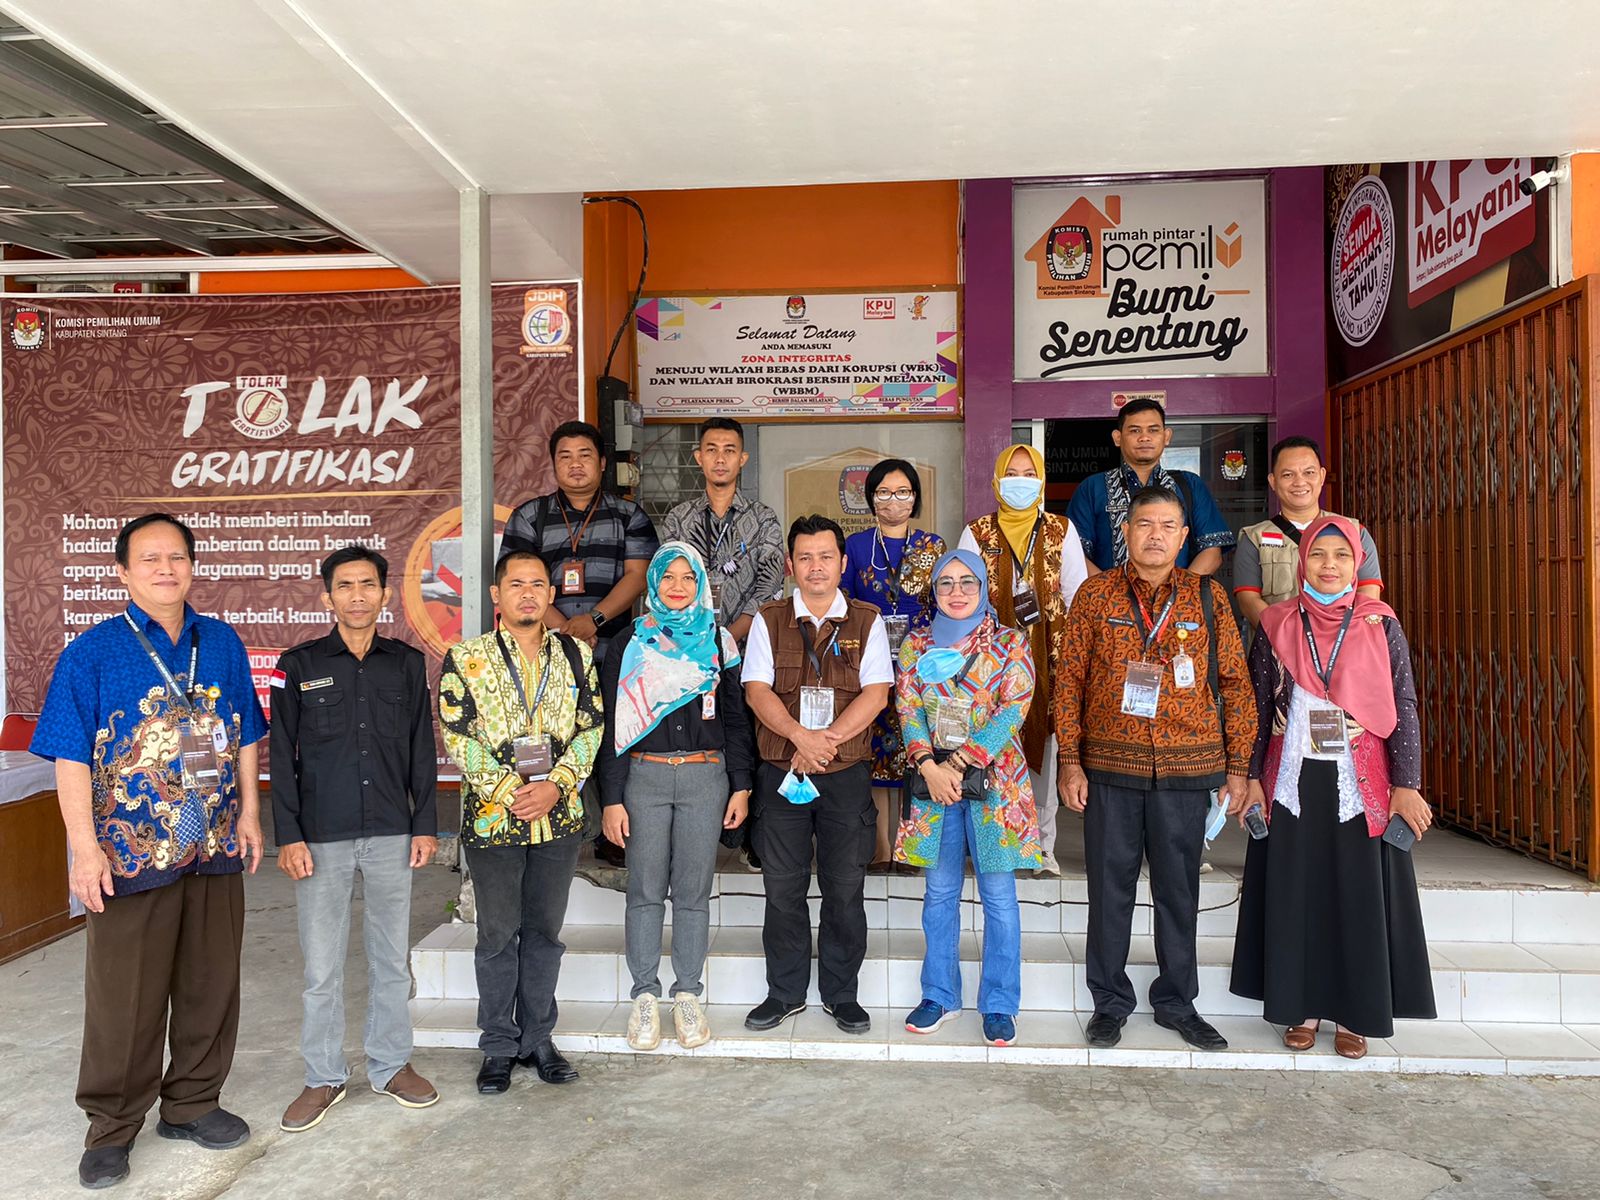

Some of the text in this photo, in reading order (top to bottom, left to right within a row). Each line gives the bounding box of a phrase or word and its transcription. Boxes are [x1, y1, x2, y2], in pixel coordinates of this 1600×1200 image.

[1416, 159, 1521, 267] Melayani
[1103, 228, 1195, 242] rumah pintar
[1343, 209, 1378, 262] SEMUA
[1380, 206, 1390, 251] PUBLIK
[1046, 254, 1076, 280] PEMILIHAN
[1081, 253, 1092, 278] UMUM
[1342, 233, 1383, 292] BERHAK
[528, 291, 563, 302] JDIH
[1107, 272, 1215, 318] Bumi
[1348, 266, 1378, 311] TAHU!
[866, 300, 892, 310] KPU
[1356, 323, 1362, 335] 14
[1362, 300, 1382, 332] TAHUN
[1380, 262, 1389, 294] 2008
[56, 316, 160, 328] KOMISI PEMILIHAN UMUM
[56, 329, 127, 339] KABUPATEN SINTANG
[736, 324, 857, 342] Selamat Datang
[1040, 312, 1248, 363] Senentang
[741, 354, 852, 363] ZONA INTEGRITAS
[656, 366, 706, 375] MENUJU
[709, 366, 763, 374] WILAYAH
[808, 365, 840, 373] DARI
[842, 364, 897, 372] KORUPSI
[900, 363, 940, 373] (WBK)
[240, 377, 282, 388] TOLAK
[650, 374, 946, 386] DAN WILAYAH BIROKRASI BERSIH DAN MELAYANI
[772, 386, 820, 396] (WBBM)
[234, 420, 288, 438] GRATIFIKASI
[1072, 446, 1109, 458] UMUM
[171, 447, 415, 488] GRATIFIKASI
[63, 514, 117, 529] Mohon
[225, 512, 298, 528] memberi
[302, 510, 371, 527] imbalan
[194, 536, 264, 552] mberian
[268, 535, 320, 551] dalam
[324, 534, 386, 550] bentuk
[63, 564, 117, 581] apapu
[192, 559, 264, 581] elayanan
[269, 564, 312, 580] yang
[224, 608, 284, 624] terbaik
[288, 607, 330, 624] kami
